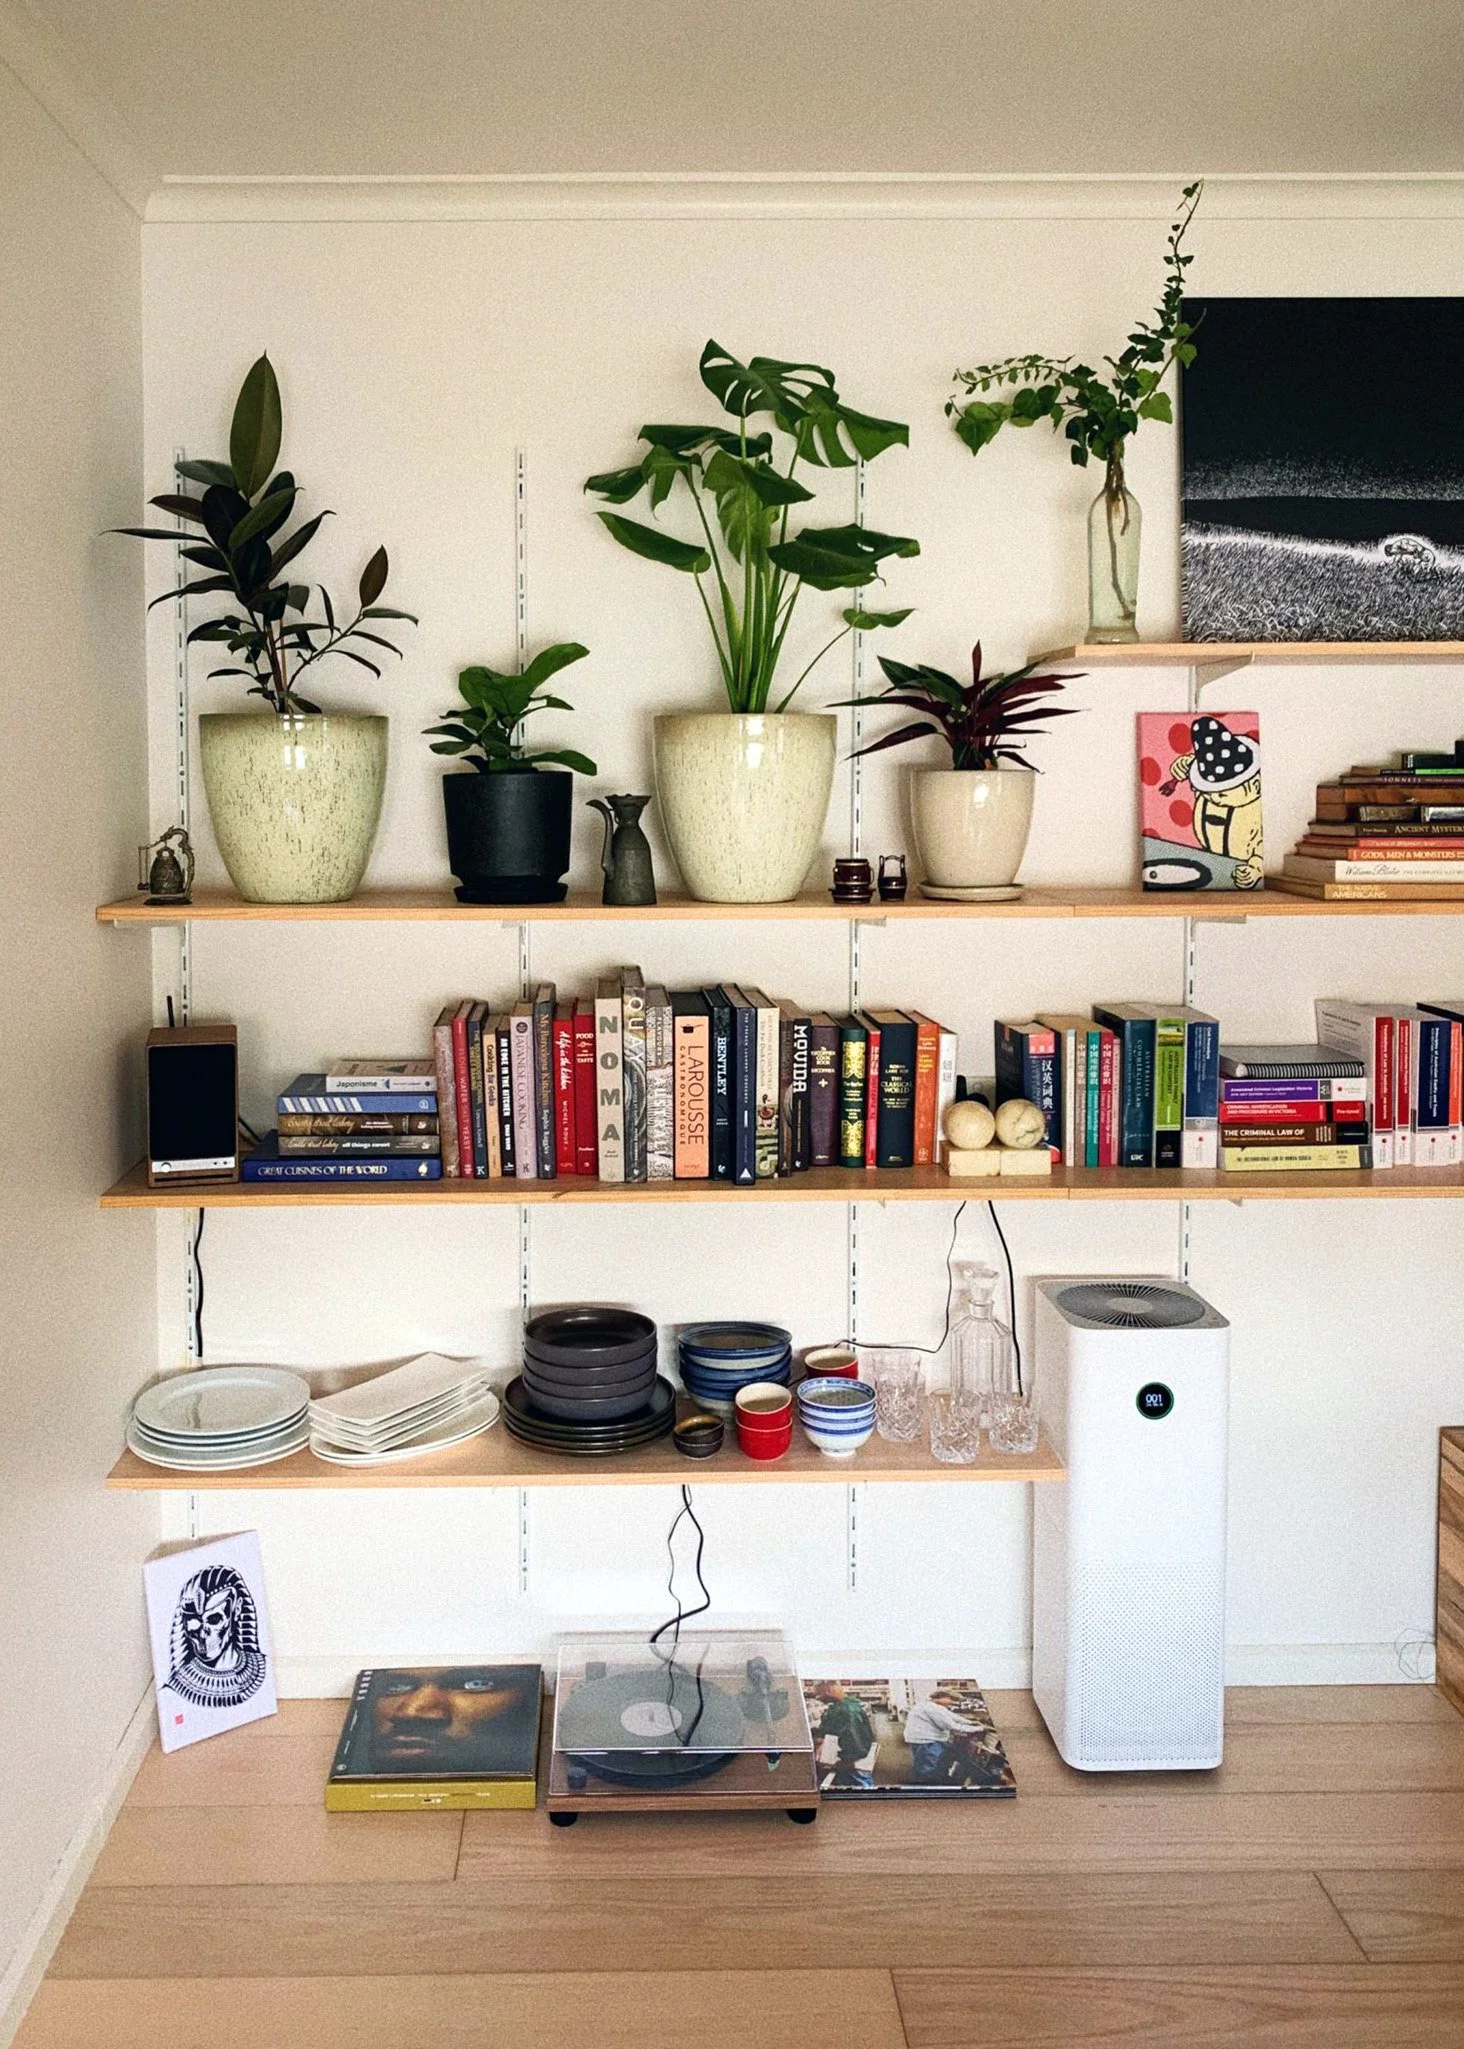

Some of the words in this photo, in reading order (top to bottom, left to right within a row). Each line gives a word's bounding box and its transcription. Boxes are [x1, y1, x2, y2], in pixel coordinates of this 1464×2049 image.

[1395, 825, 1429, 833] ANCIENT
[576, 1032, 594, 1040] FOOD
[628, 996, 643, 1064] QUAY
[486, 1044, 496, 1073] Cooking
[501, 1048, 509, 1066] EDGE
[717, 1036, 727, 1096] BENTLEY
[336, 1080, 378, 1088] Japonisme
[459, 1076, 468, 1103] WATER
[502, 1075, 510, 1088] THE
[599, 1015, 620, 1141] NOMA
[1042, 1059, 1053, 1110] 汉英词典
[502, 1089, 511, 1117] KITCHEN
[687, 1045, 705, 1145] LAROUSSE
[463, 1125, 471, 1150] YEAST
[258, 1166, 283, 1176] GREAT
[284, 1166, 322, 1176] CUISINES
[323, 1166, 337, 1175] OF
[339, 1165, 356, 1174] THE
[355, 1164, 388, 1175] WORLD
